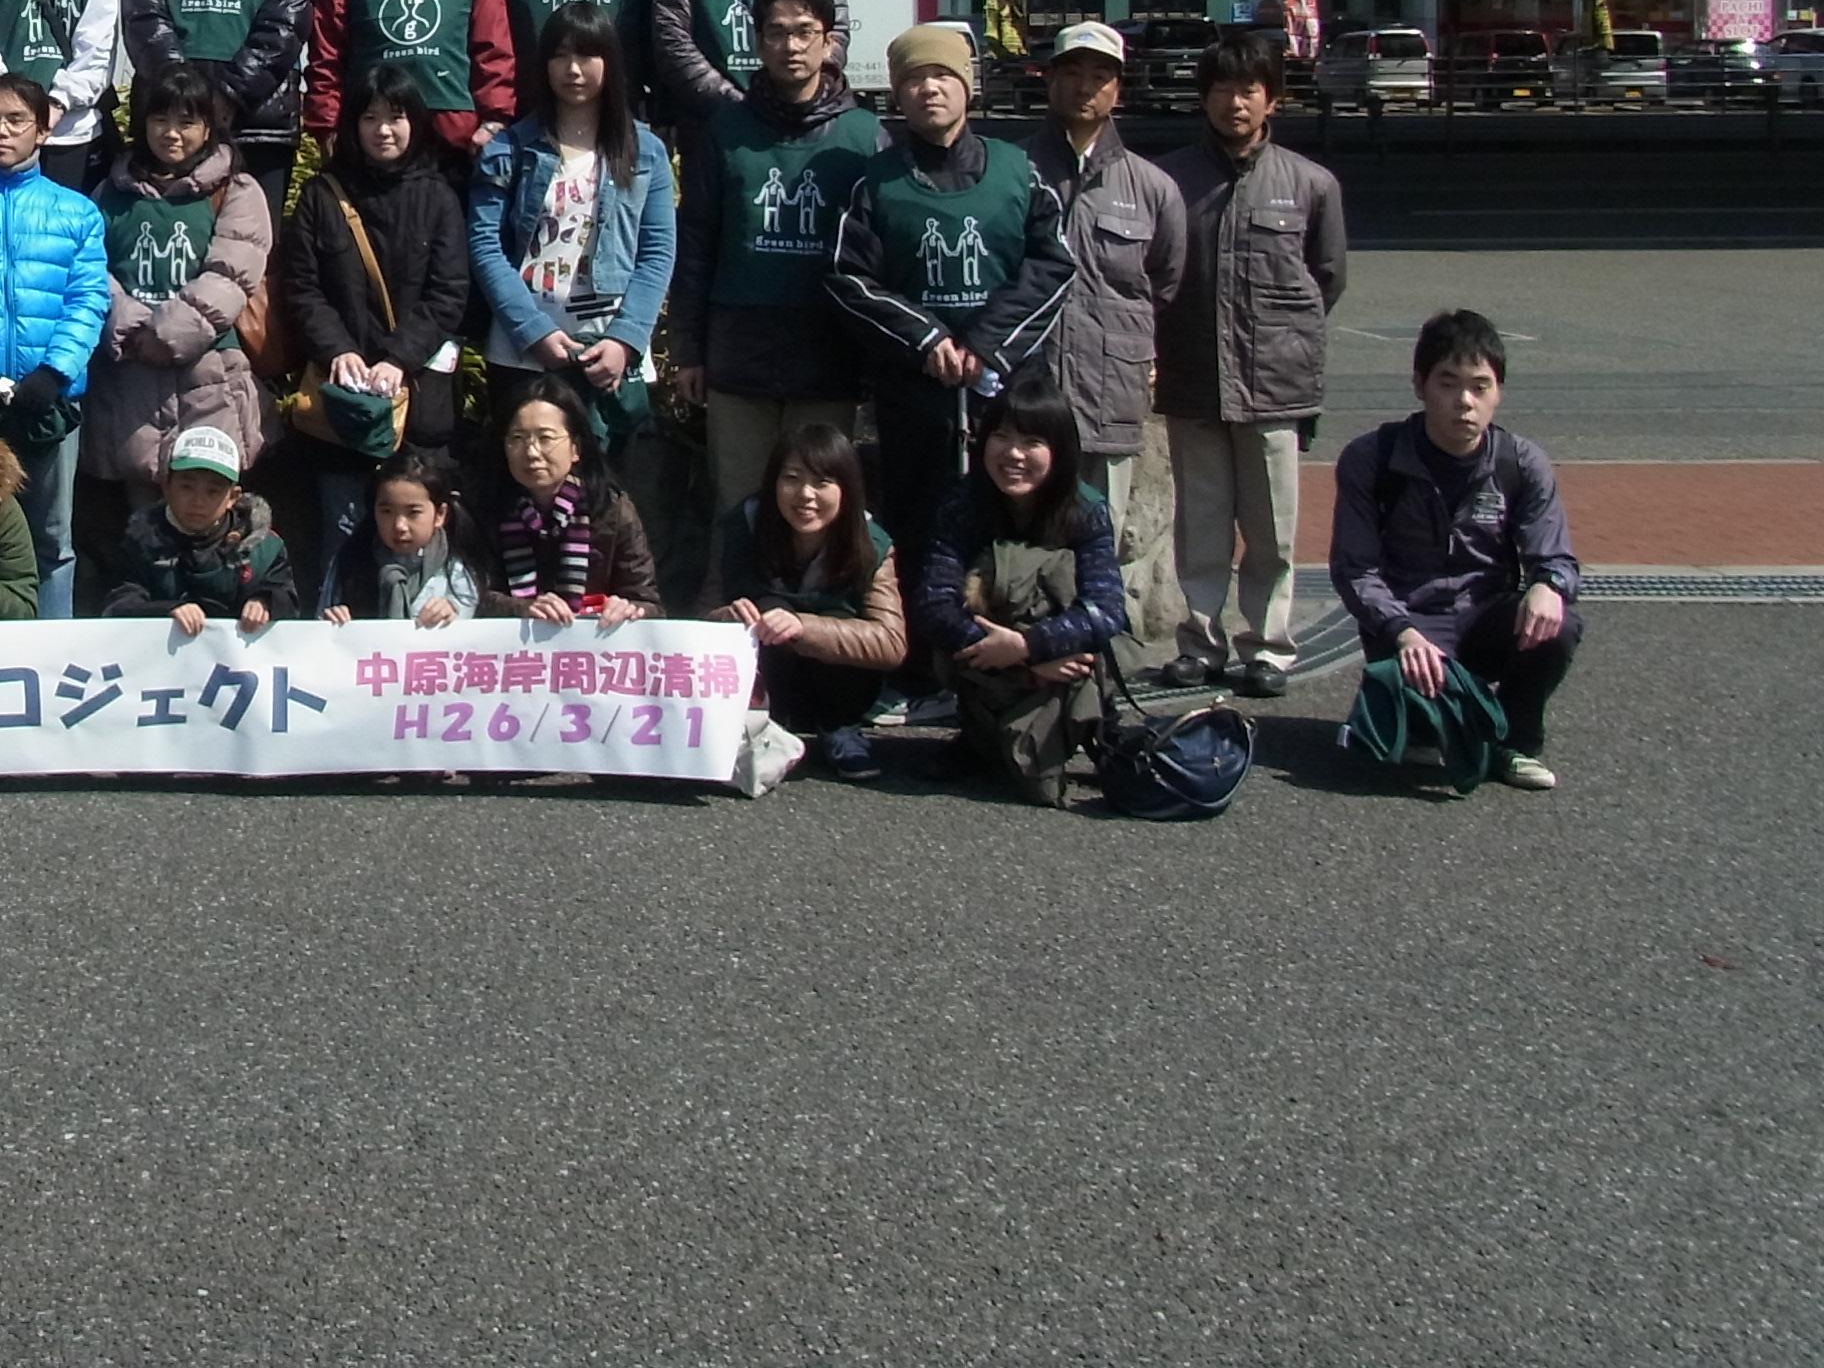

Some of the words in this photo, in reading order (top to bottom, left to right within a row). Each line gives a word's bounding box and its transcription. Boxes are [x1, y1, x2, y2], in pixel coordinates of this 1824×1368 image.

[355, 650, 741, 698] 中原海岸周辺清掃
[393, 702, 704, 749] H26/3/21
